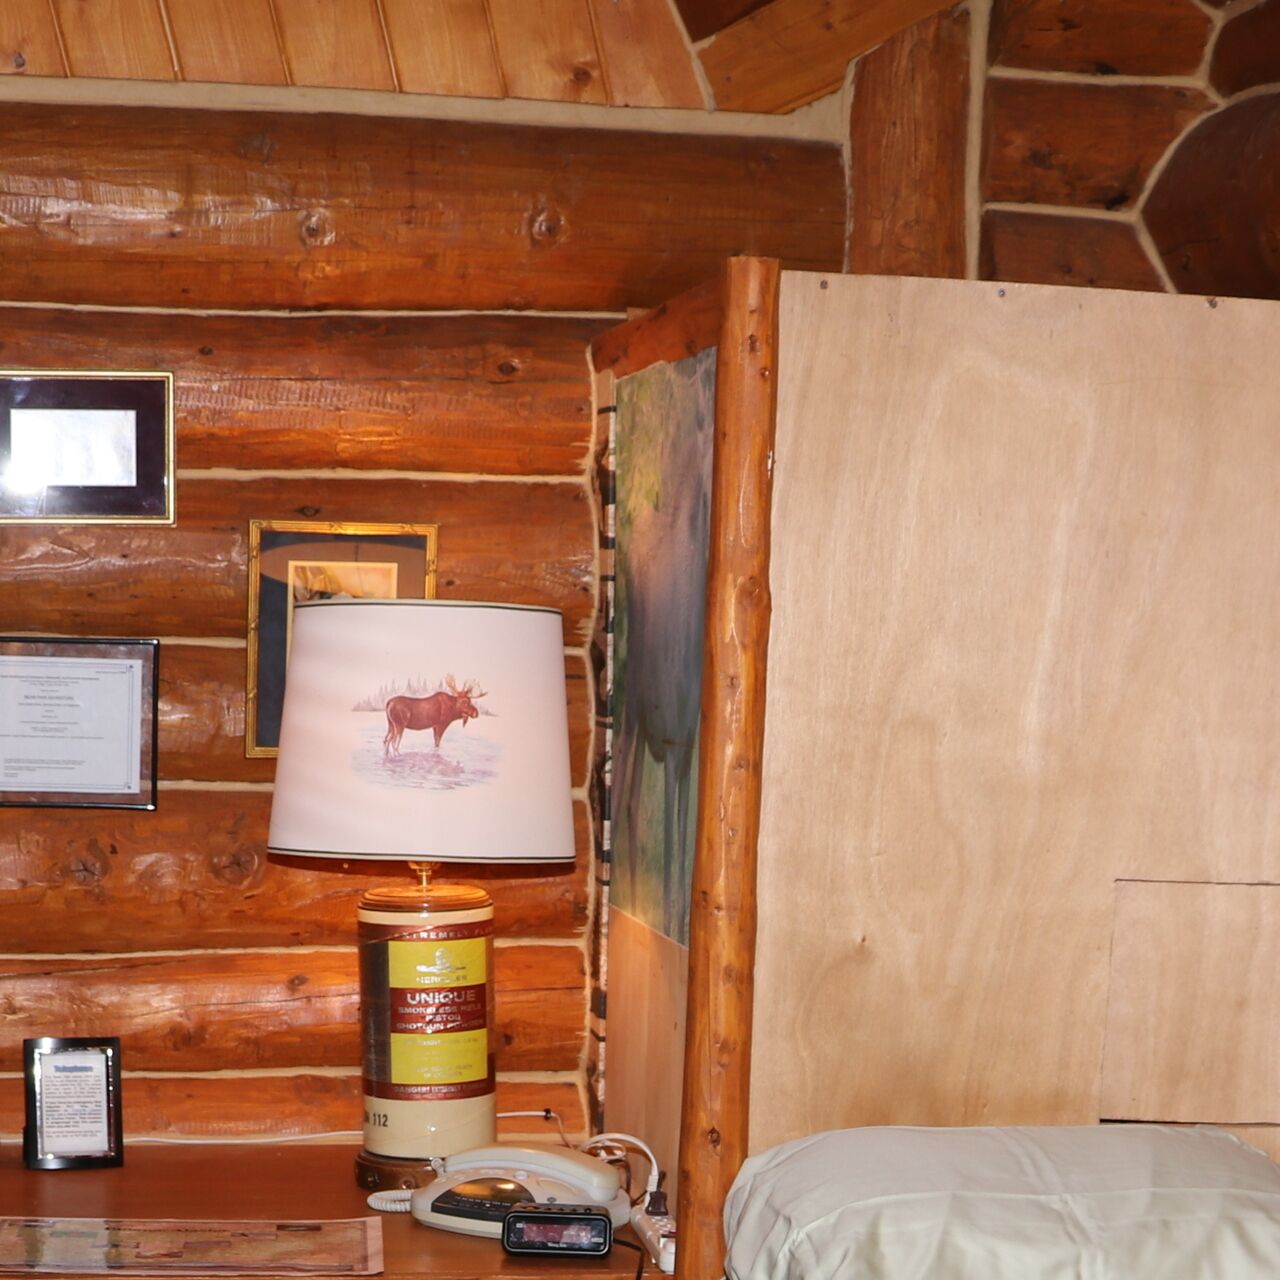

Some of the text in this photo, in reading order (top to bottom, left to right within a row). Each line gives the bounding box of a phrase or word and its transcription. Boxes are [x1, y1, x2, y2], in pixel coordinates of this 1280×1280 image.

[393, 928, 469, 939] XTREMELY
[407, 990, 476, 1004] UNIQUE
[372, 1112, 389, 1128] 112
